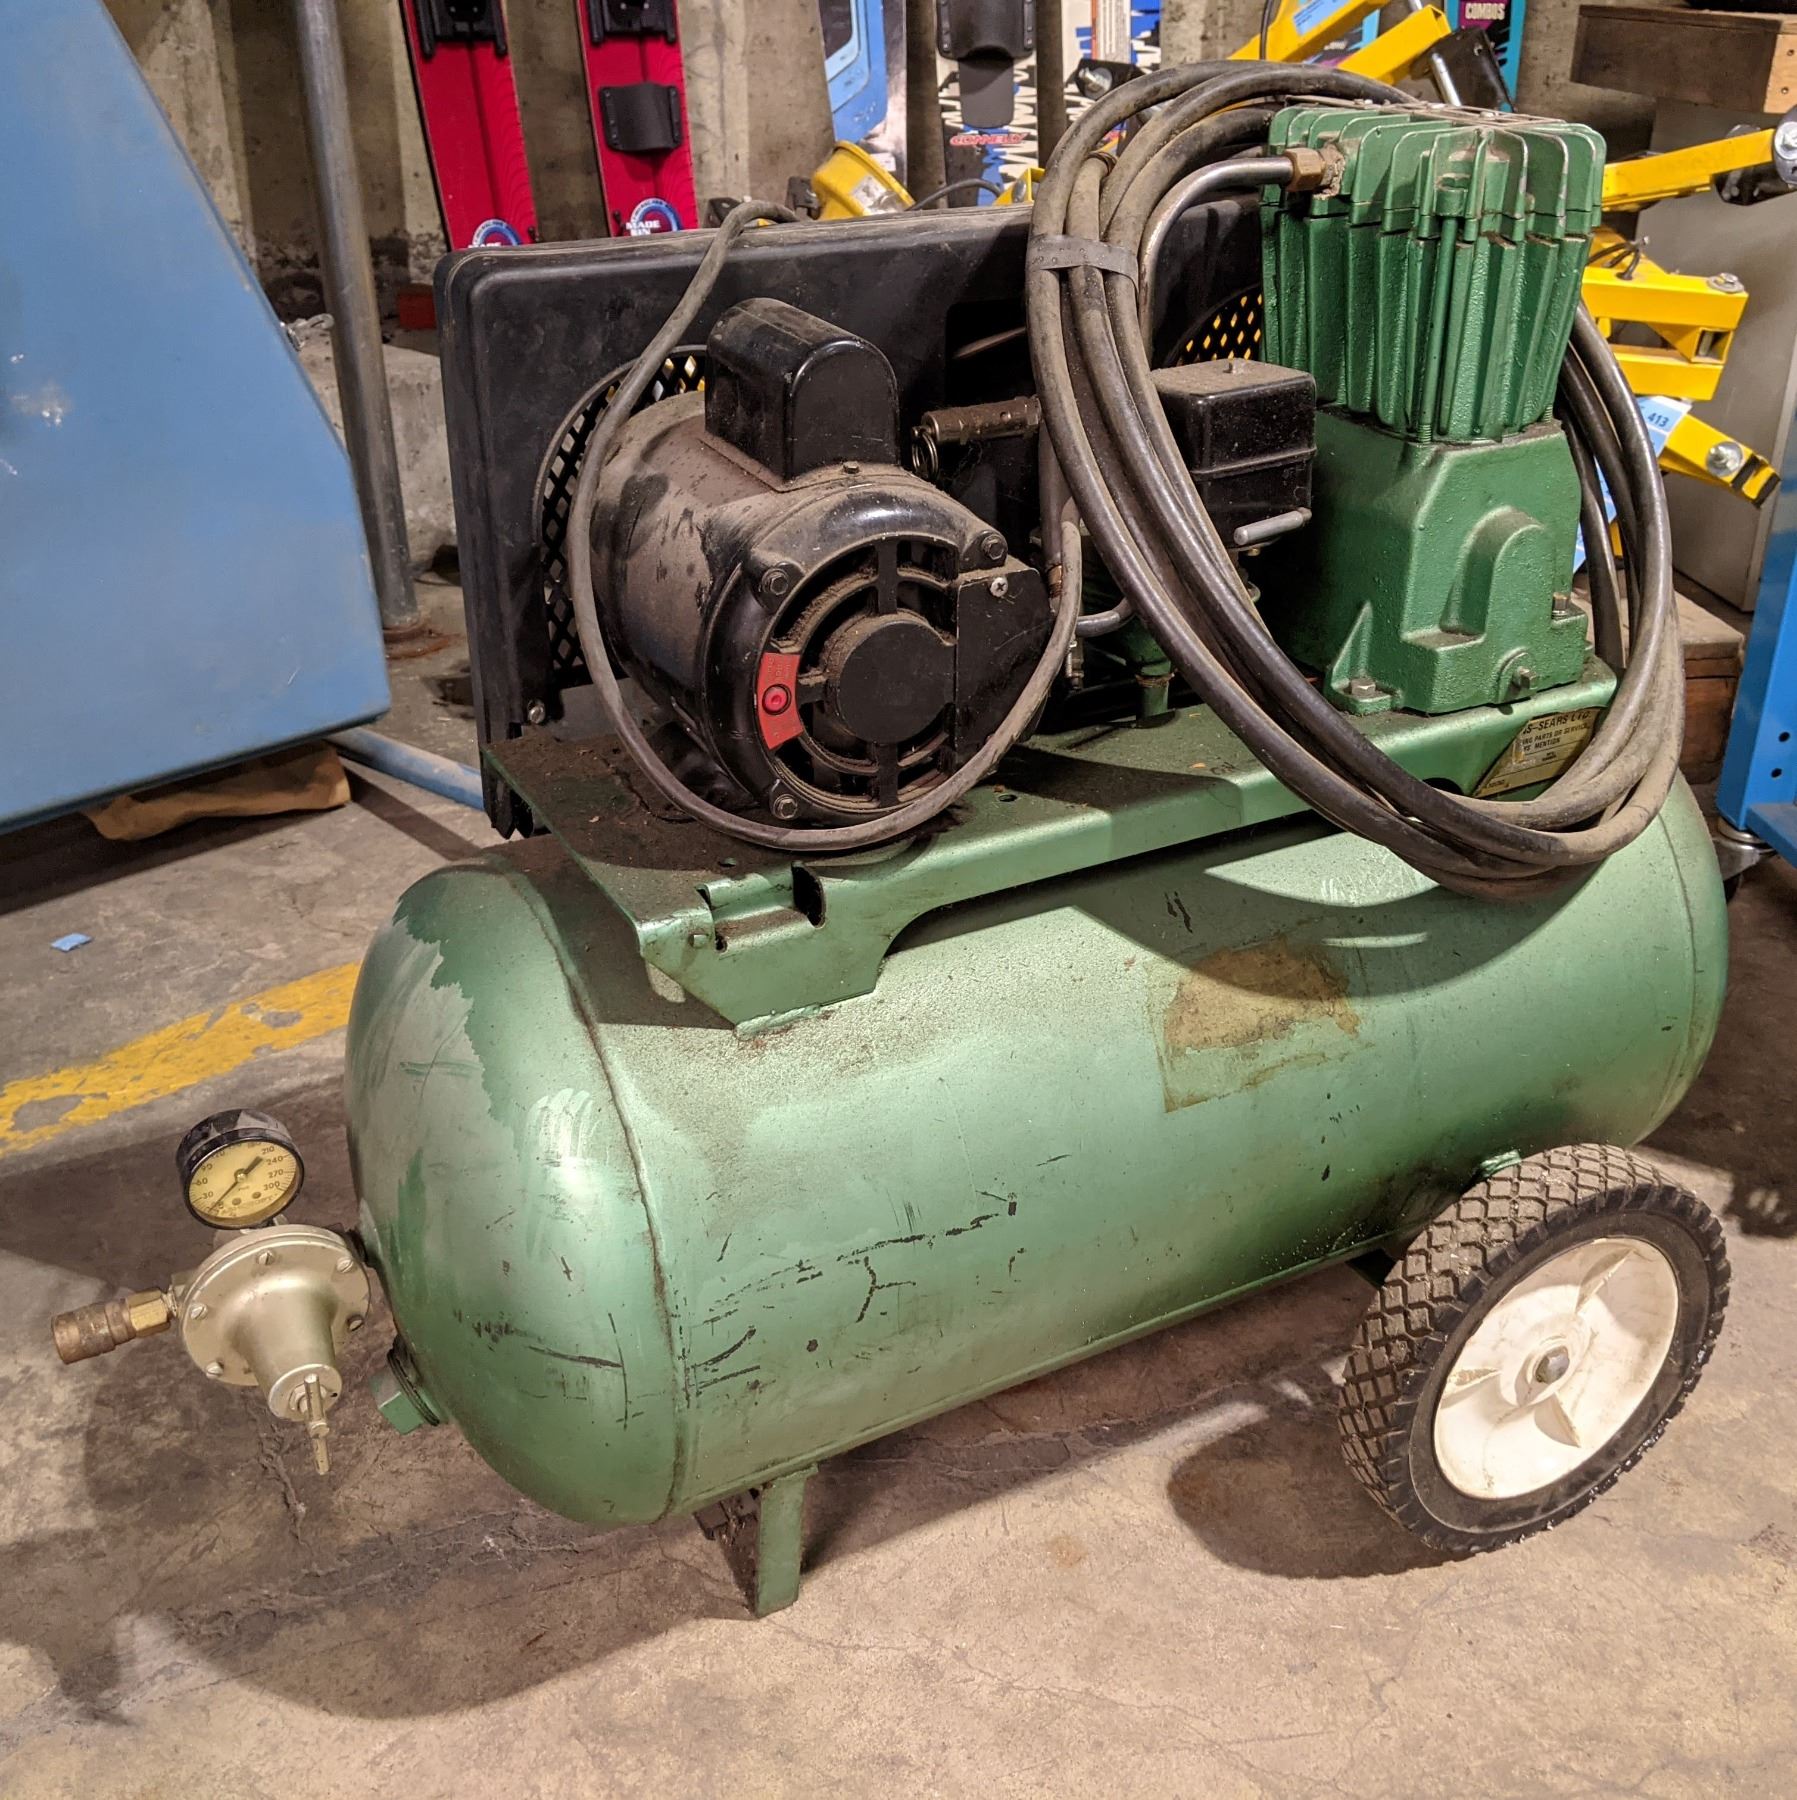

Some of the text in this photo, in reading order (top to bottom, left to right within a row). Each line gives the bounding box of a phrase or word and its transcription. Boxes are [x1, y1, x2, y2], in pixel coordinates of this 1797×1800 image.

[1465, 3, 1506, 20] COMBOS
[626, 219, 660, 230] MADE
[1648, 413, 1669, 427] 413
[1535, 738, 1561, 748] MENTION
[262, 1146, 275, 1155] 210
[267, 1156, 284, 1165] 240
[202, 1163, 213, 1171] 90
[268, 1168, 284, 1178] 270
[197, 1177, 208, 1186] 60
[264, 1181, 281, 1191] 300
[203, 1191, 214, 1199] 30
